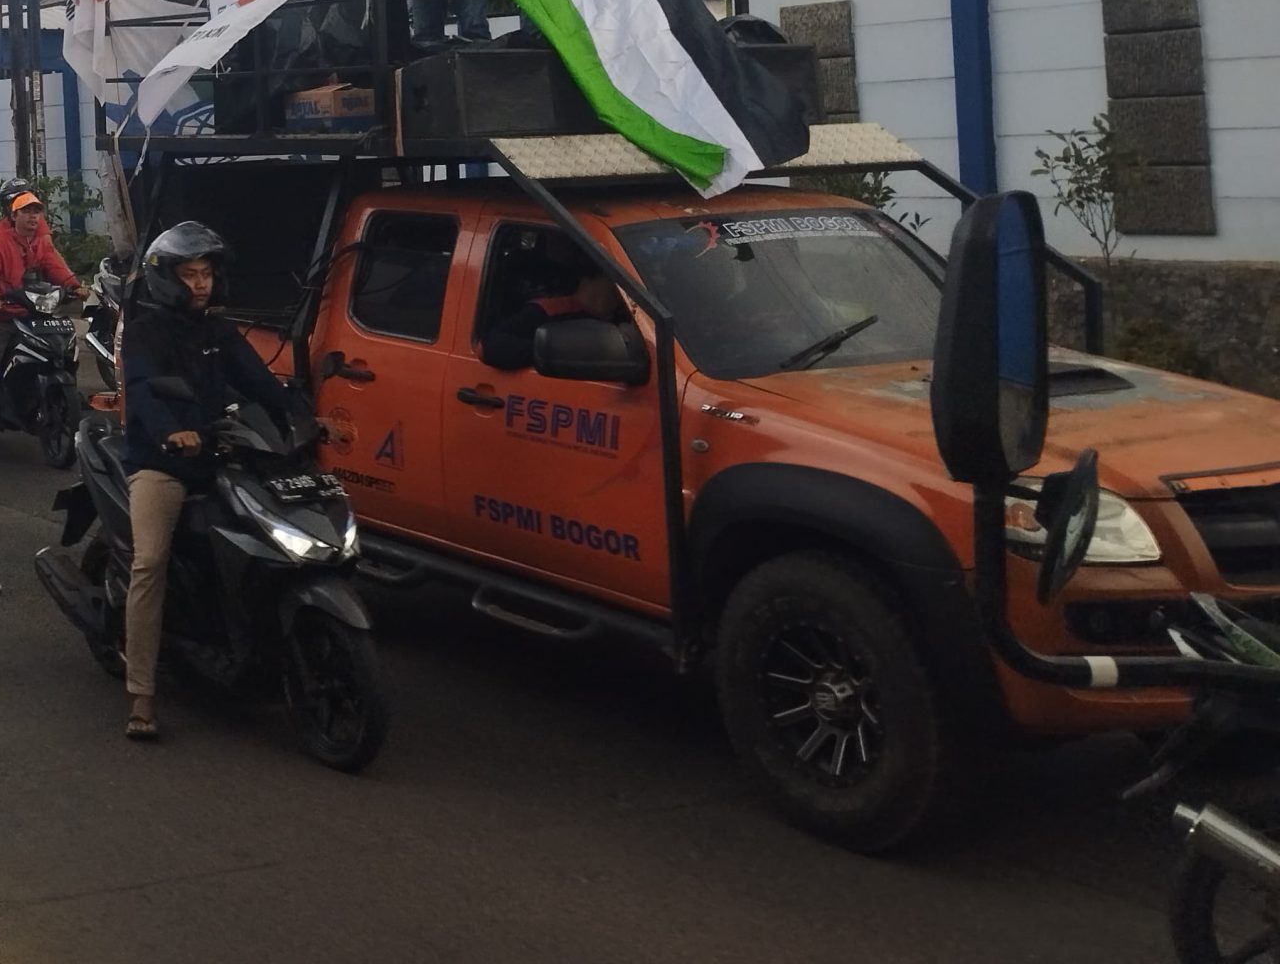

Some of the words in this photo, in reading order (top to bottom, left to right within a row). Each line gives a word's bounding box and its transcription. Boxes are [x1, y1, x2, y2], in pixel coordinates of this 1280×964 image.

[722, 218, 794, 238] FSPMI
[790, 216, 868, 232] BOGOR
[505, 394, 620, 450] FSPMI
[474, 494, 542, 534] FSPMI
[550, 514, 641, 562] BOGOR
